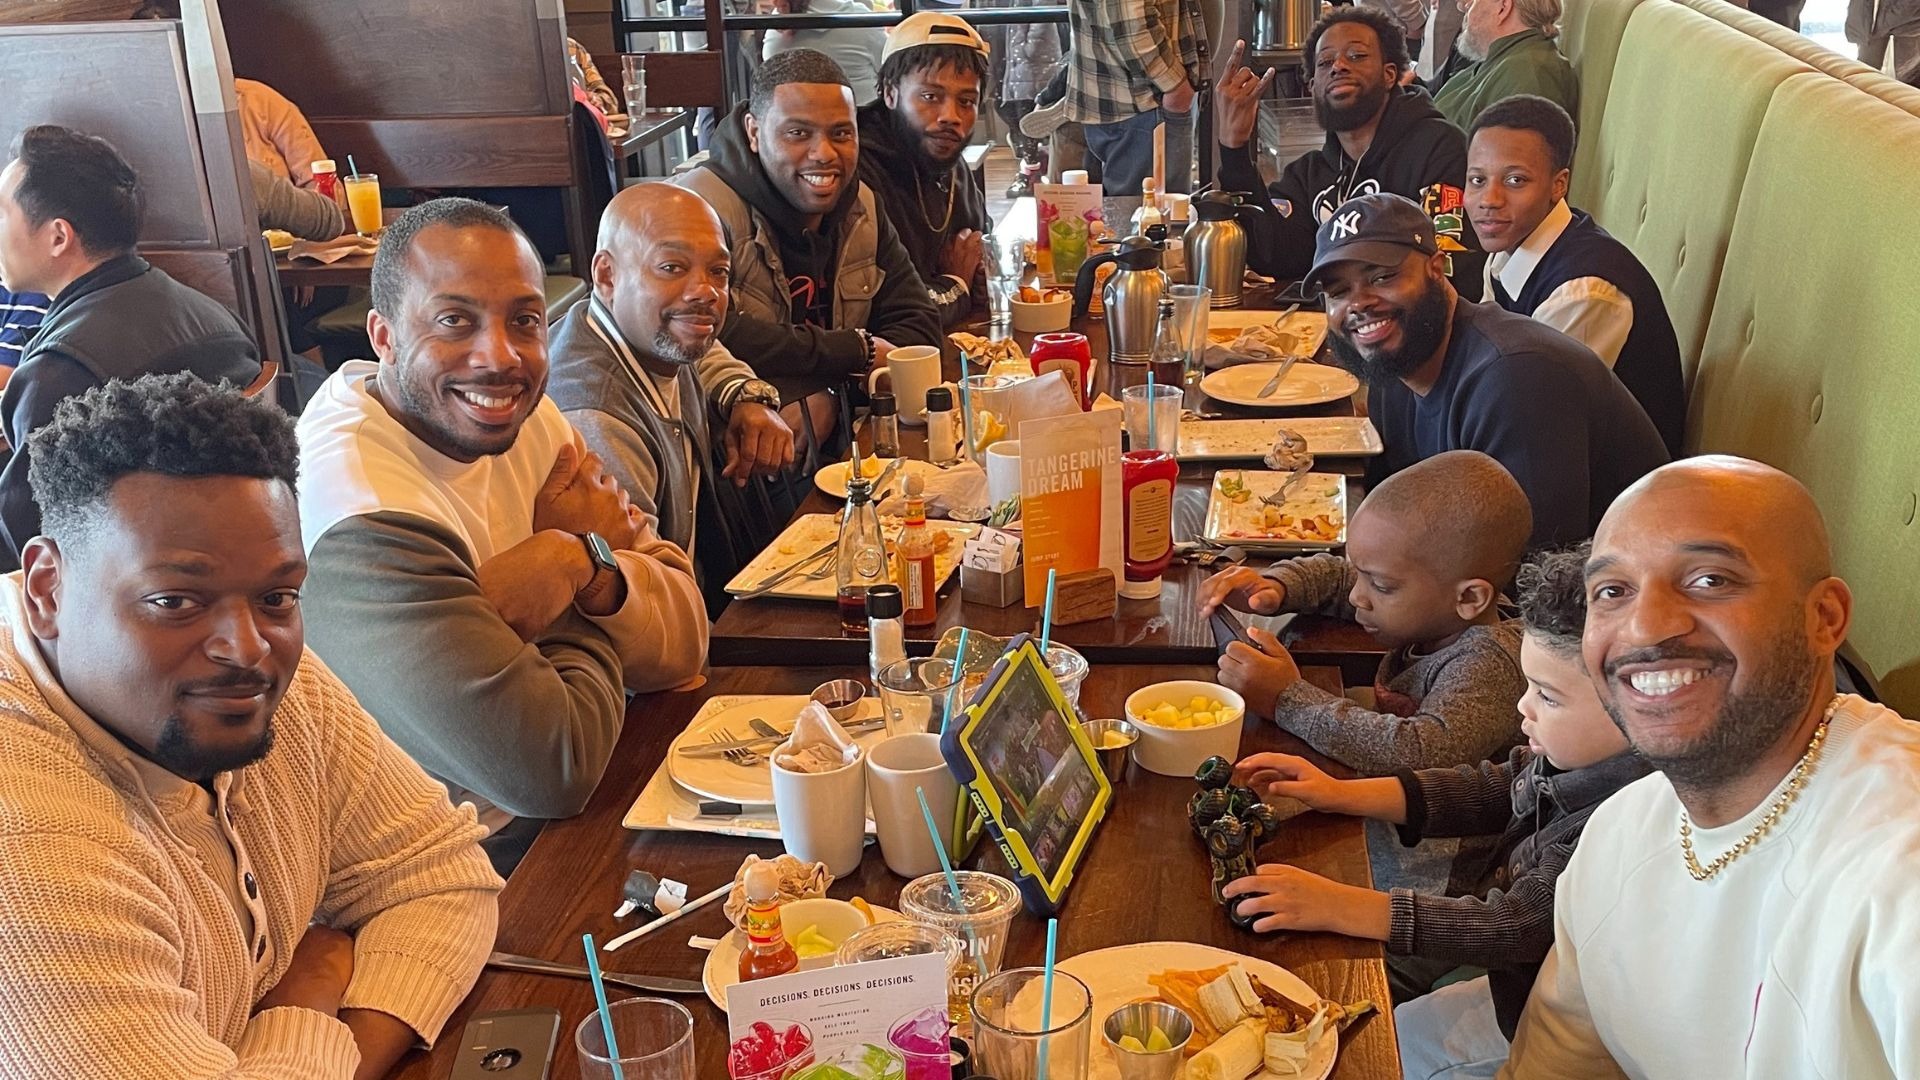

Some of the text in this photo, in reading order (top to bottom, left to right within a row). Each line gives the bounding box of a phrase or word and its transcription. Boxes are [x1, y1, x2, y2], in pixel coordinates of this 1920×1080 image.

[1330, 210, 1361, 242] NY
[1027, 446, 1116, 477] TANGERINE
[1027, 470, 1083, 498] DREAM
[760, 990, 811, 1007] DECISIONS.
[866, 974, 917, 989] DECISIONS.
